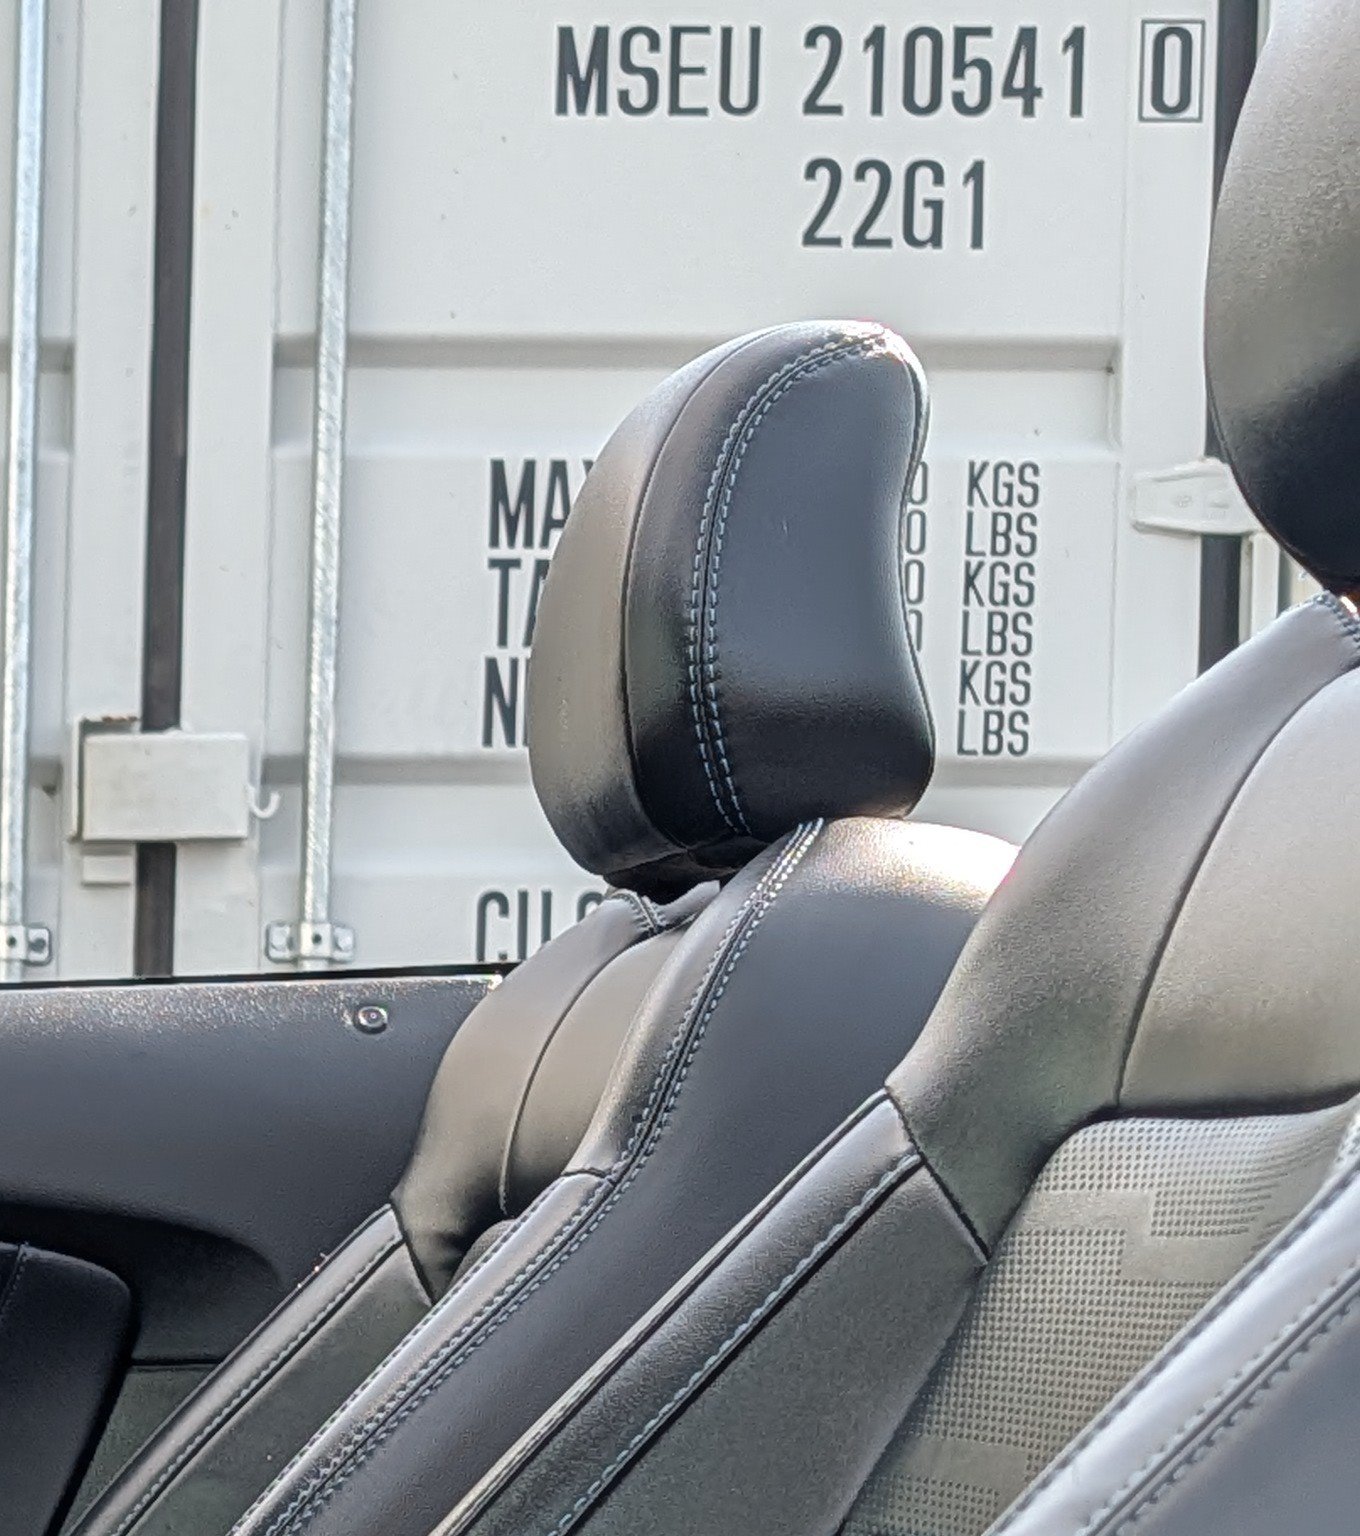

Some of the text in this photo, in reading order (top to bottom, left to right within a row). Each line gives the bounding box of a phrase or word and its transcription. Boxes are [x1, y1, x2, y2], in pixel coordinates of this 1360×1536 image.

[555, 25, 1193, 118] MSEU 210541 0
[802, 157, 985, 250] 22G1
[488, 459, 594, 549] MA
[967, 460, 1040, 508] KGS
[965, 510, 1038, 558] LBS
[963, 560, 1035, 608] KGS
[961, 609, 1033, 657] LBS
[482, 657, 530, 747] N
[958, 659, 1031, 707] KGS
[956, 708, 1029, 757] LBS
